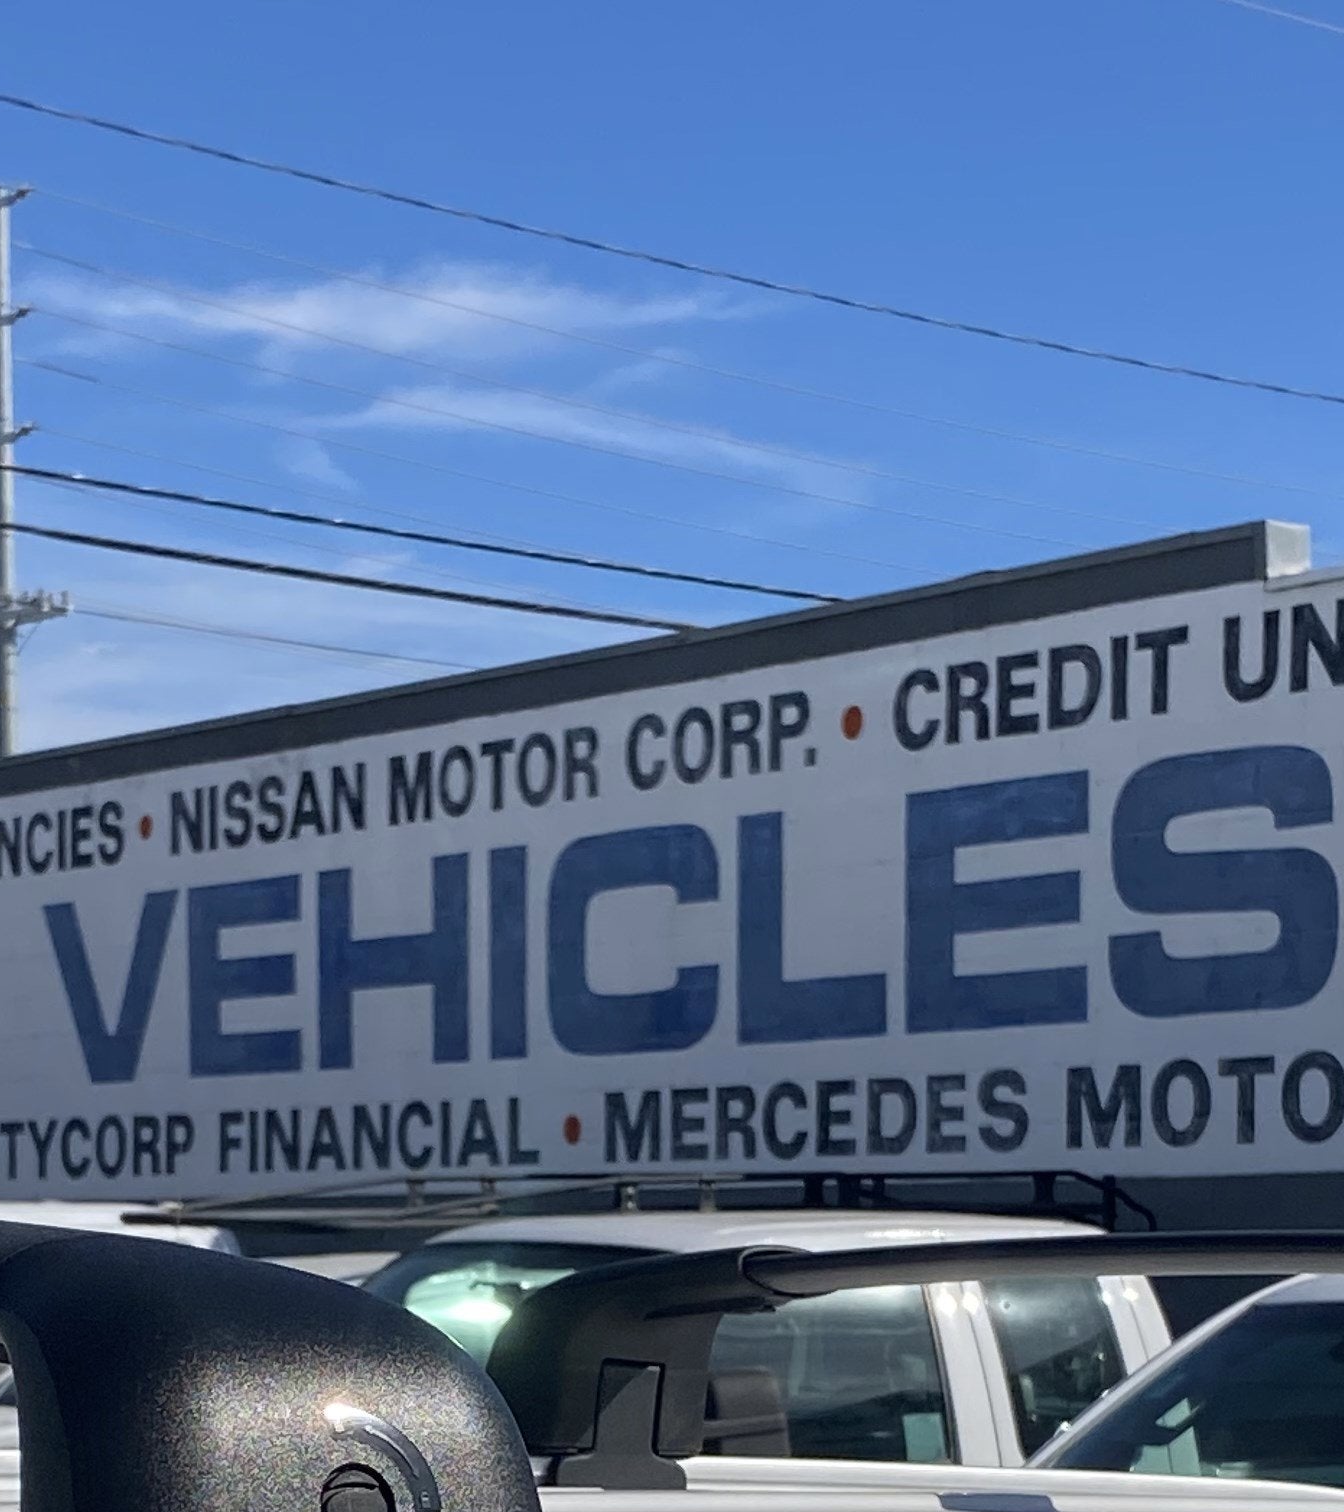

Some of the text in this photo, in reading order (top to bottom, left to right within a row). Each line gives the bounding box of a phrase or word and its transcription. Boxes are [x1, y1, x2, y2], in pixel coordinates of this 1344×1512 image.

[169, 762, 366, 857] NISSAN
[388, 724, 599, 828] MOTOR
[626, 691, 817, 791] CORP.
[892, 623, 1189, 751] CREDIT
[42, 744, 1339, 1083] VEHICLES
[219, 1098, 540, 1174] FINANCIAL
[604, 1069, 1029, 1163] MERCEDES
